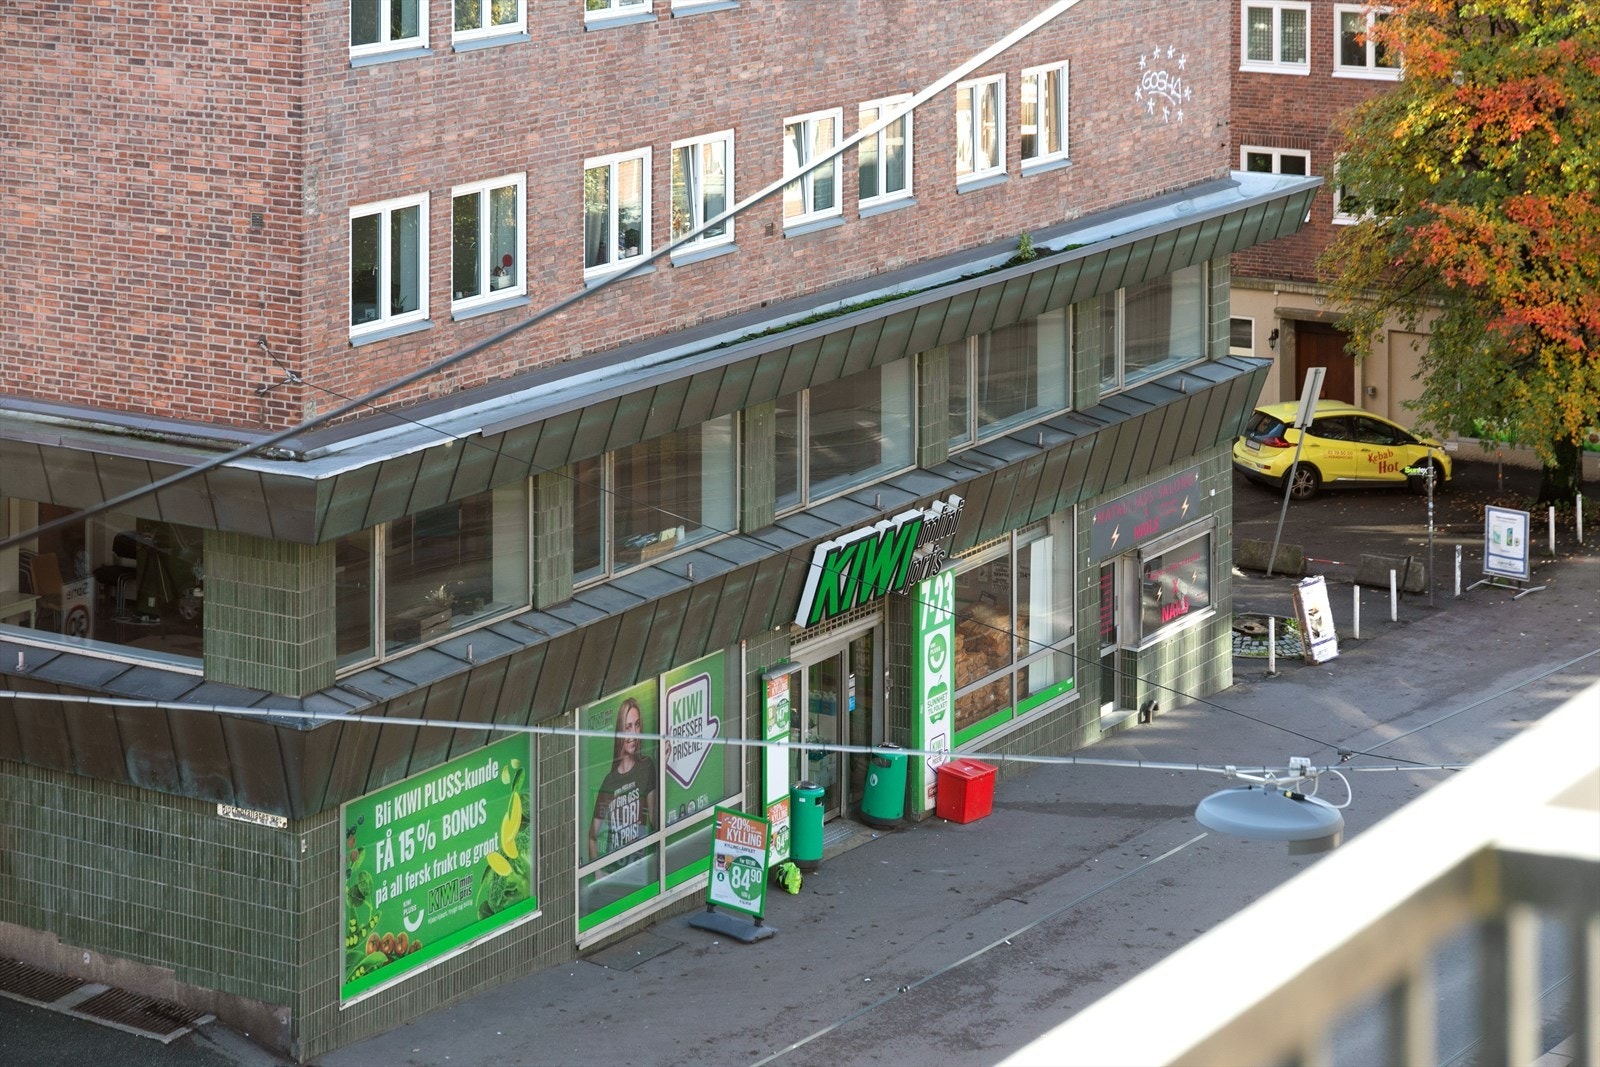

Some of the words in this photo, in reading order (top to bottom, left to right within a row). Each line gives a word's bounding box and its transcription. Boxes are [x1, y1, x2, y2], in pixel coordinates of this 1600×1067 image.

[1367, 449, 1394, 464] Kebab
[1379, 461, 1399, 475] Hot
[918, 498, 966, 548] mini
[1133, 516, 1161, 540] NAILS
[801, 511, 925, 628] KIWI
[901, 547, 946, 595] pris
[921, 571, 953, 631] 7-23
[673, 689, 703, 726] KIWI
[673, 717, 703, 744] PRESSER
[375, 800, 391, 829] Bli
[394, 787, 422, 820] KIWI
[424, 757, 499, 808] PLUSS-kunde
[628, 788, 640, 803] OSS
[376, 828, 395, 874] FÅ
[442, 798, 487, 840] BONUS
[726, 828, 762, 848] KYLLING
[727, 816, 750, 833] -20%
[376, 880, 388, 909] på
[390, 874, 403, 899] all
[405, 863, 431, 891] fersk
[433, 850, 458, 879] frukt
[460, 848, 472, 868] og
[473, 832, 499, 865] grønt
[731, 865, 751, 891] 84
[750, 868, 763, 884] 90
[428, 879, 459, 915] KIWI
